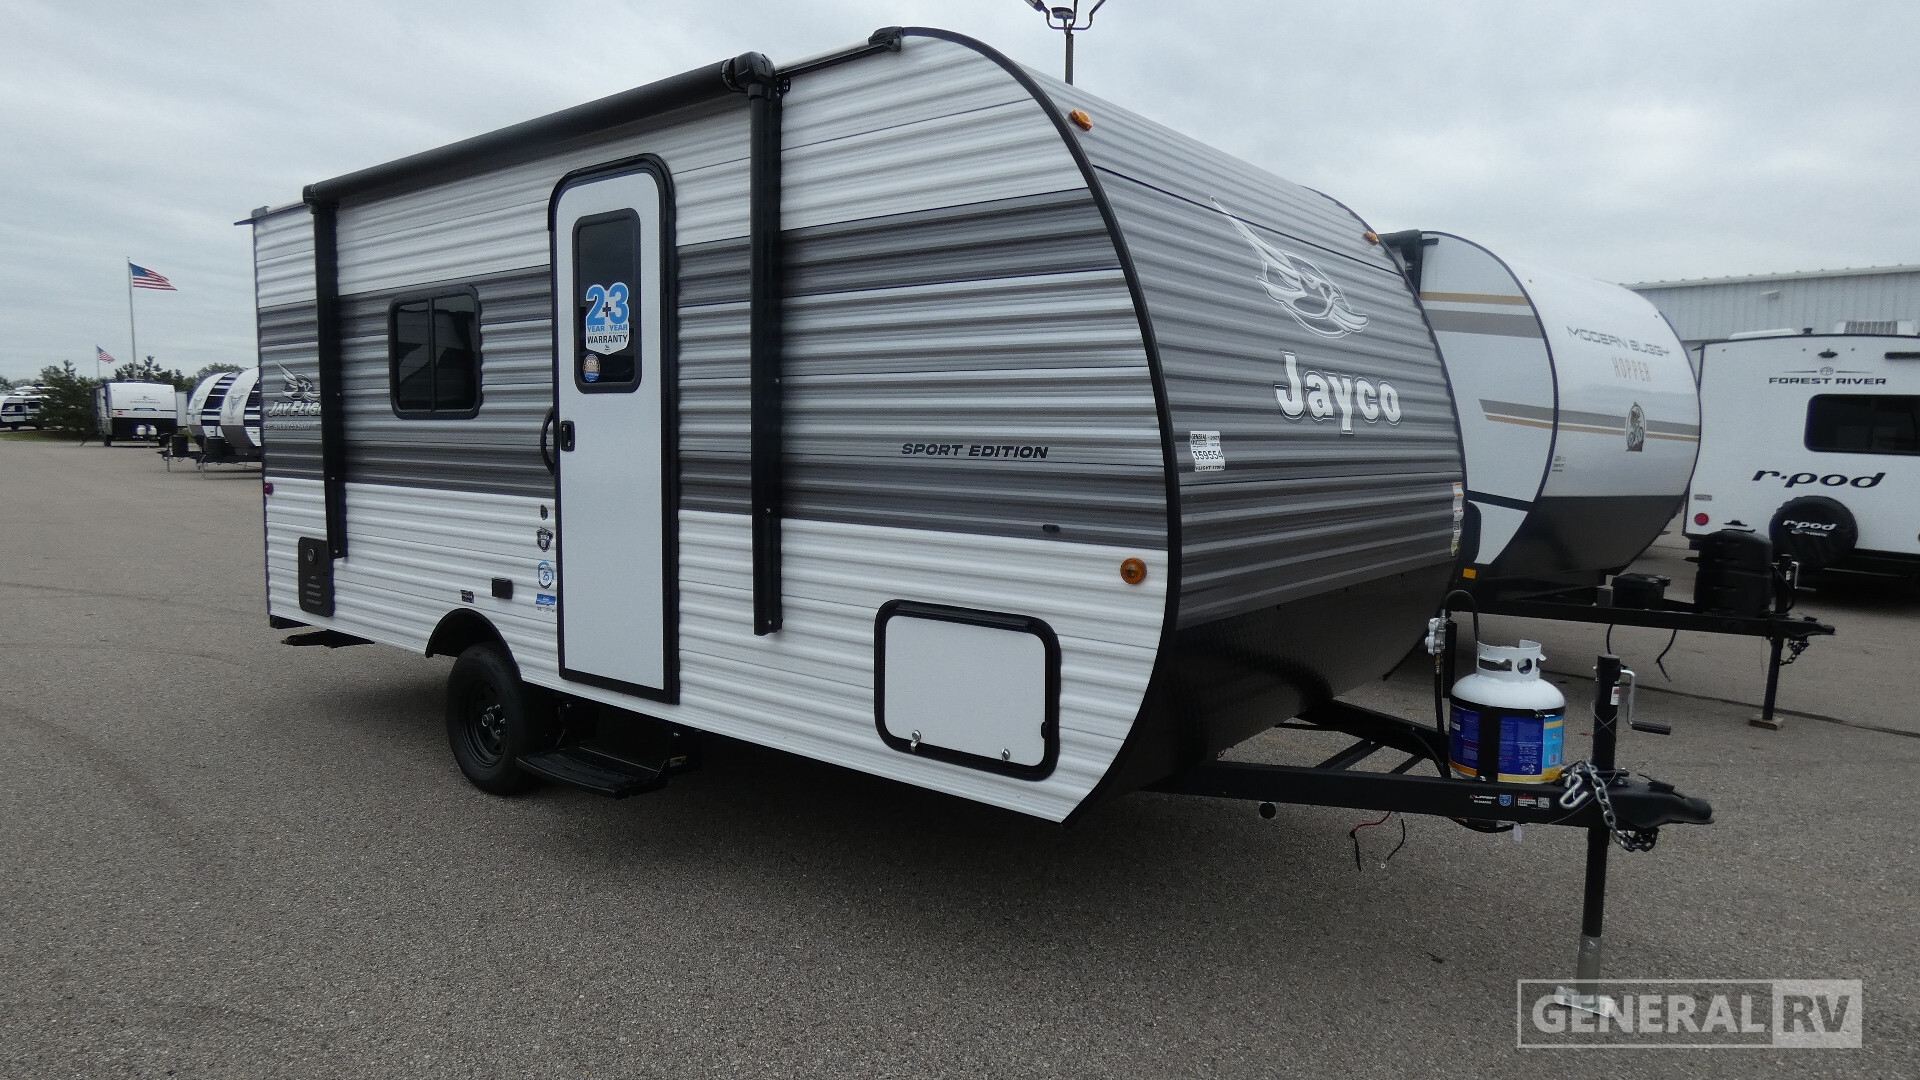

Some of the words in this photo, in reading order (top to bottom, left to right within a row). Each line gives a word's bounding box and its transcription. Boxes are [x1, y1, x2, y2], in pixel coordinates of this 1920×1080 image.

[587, 334, 628, 344] WARRANTY
[1566, 326, 1628, 349] MODERN
[1629, 339, 1670, 358] BUGGY
[1612, 357, 1651, 382] HOPPER
[1768, 377, 1832, 385] FOREST
[1835, 377, 1887, 385] RIVER
[1273, 351, 1402, 435] Jayco
[268, 401, 292, 417] JAY
[290, 400, 321, 416] FLIG
[902, 442, 964, 457] SPORT
[968, 444, 1049, 459] EDITION
[1193, 450, 1224, 460] 359554
